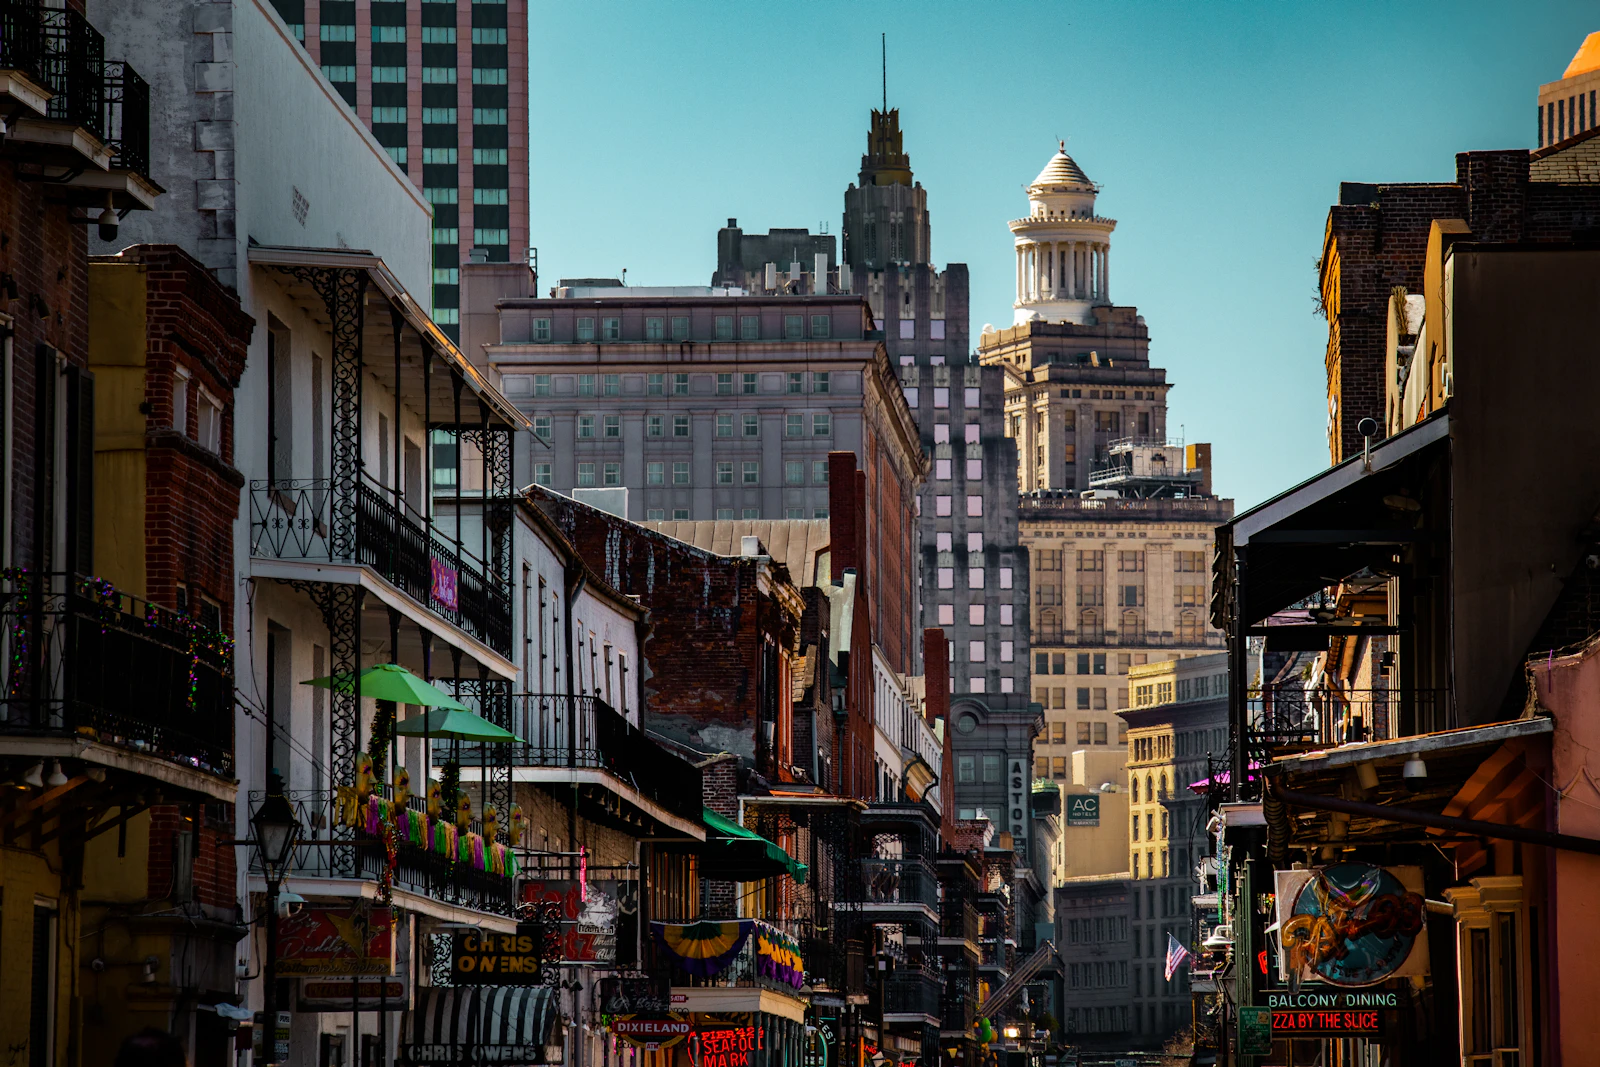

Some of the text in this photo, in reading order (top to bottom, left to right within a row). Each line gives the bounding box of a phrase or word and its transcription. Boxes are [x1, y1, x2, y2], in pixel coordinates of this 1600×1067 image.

[1012, 761, 1023, 836] ASTOR
[1072, 798, 1096, 811] AC
[280, 911, 322, 938] Big
[463, 935, 534, 953] CHRIS
[457, 955, 538, 974] OWENS
[337, 984, 351, 997] BY
[356, 984, 372, 997] HE
[1268, 993, 1397, 1008] BALCONY DINING
[617, 1022, 690, 1033] DIXIELAND
[1272, 1013, 1296, 1029] ZZA
[1298, 1013, 1315, 1029] BY
[1317, 1013, 1341, 1029] THE
[1344, 1012, 1379, 1029] SLICE
[701, 1030, 735, 1041] PIER
[408, 1044, 537, 1062] CHRIS OWENS
[646, 1042, 660, 1050] ATM
